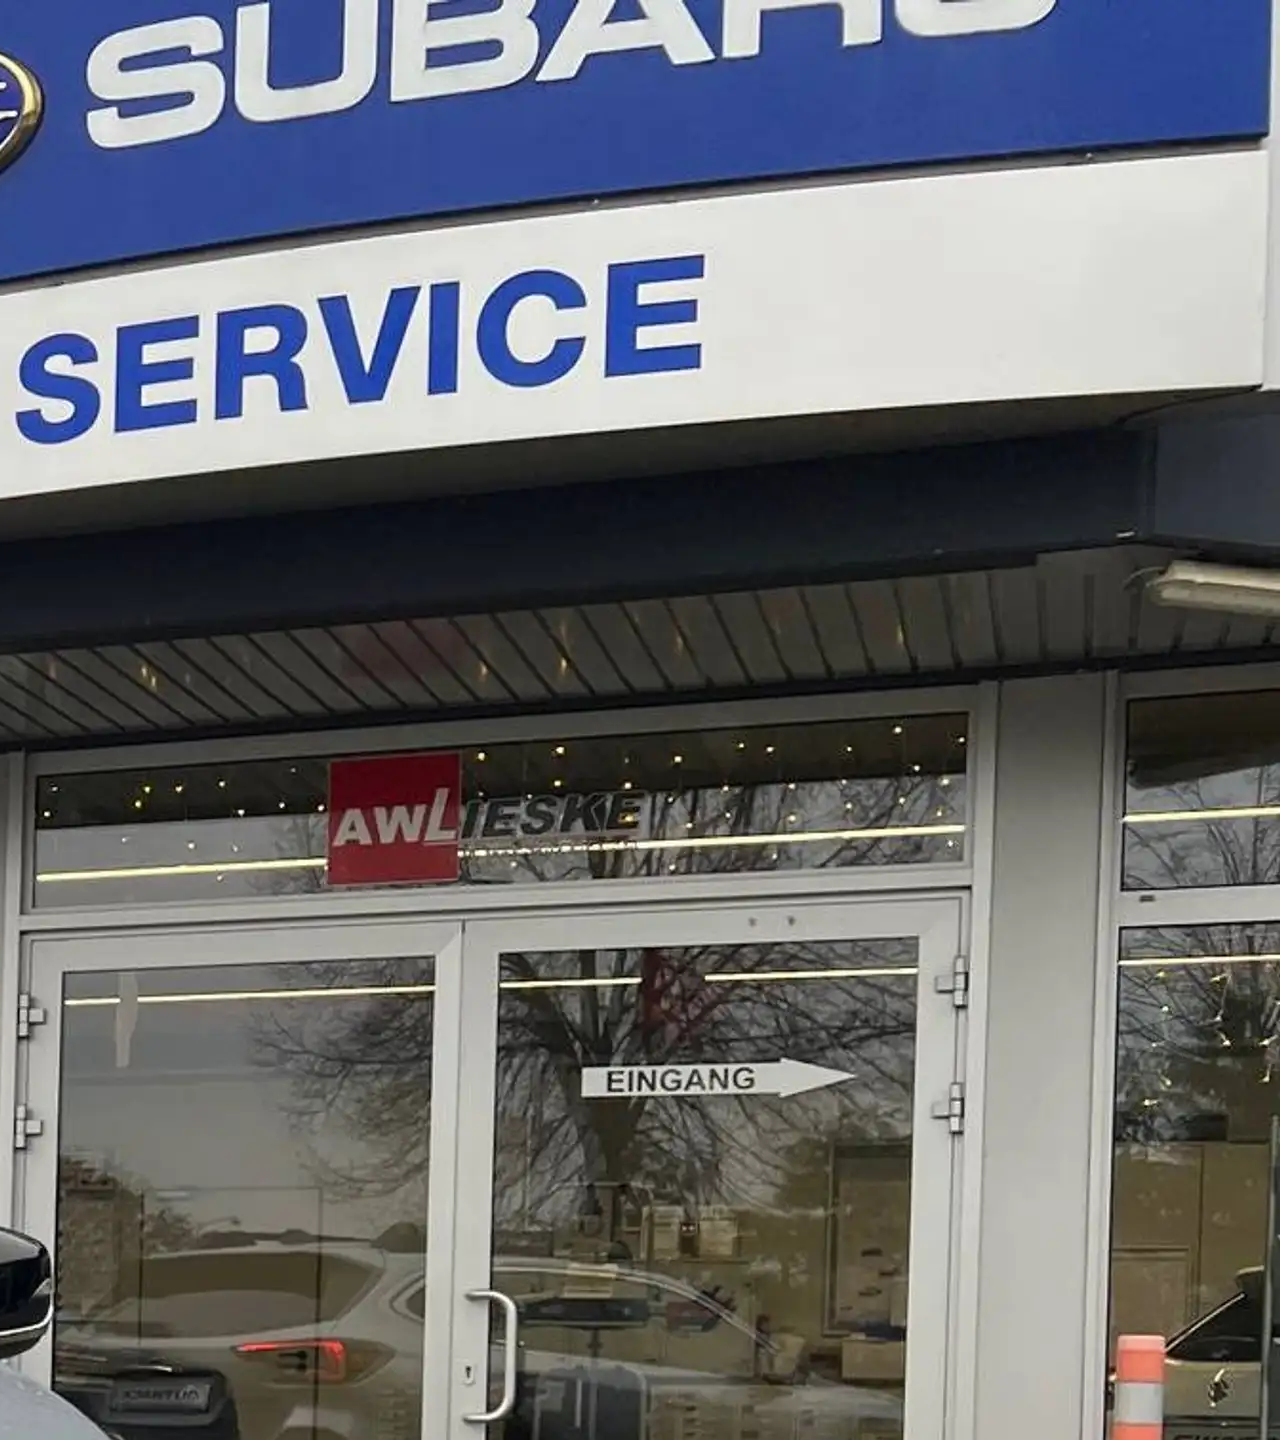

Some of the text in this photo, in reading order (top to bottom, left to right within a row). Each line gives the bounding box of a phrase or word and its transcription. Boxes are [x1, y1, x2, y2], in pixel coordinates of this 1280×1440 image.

[85, 0, 1057, 149] SUBA
[15, 254, 705, 445] SERVICE
[606, 1066, 756, 1093] EINGANG
